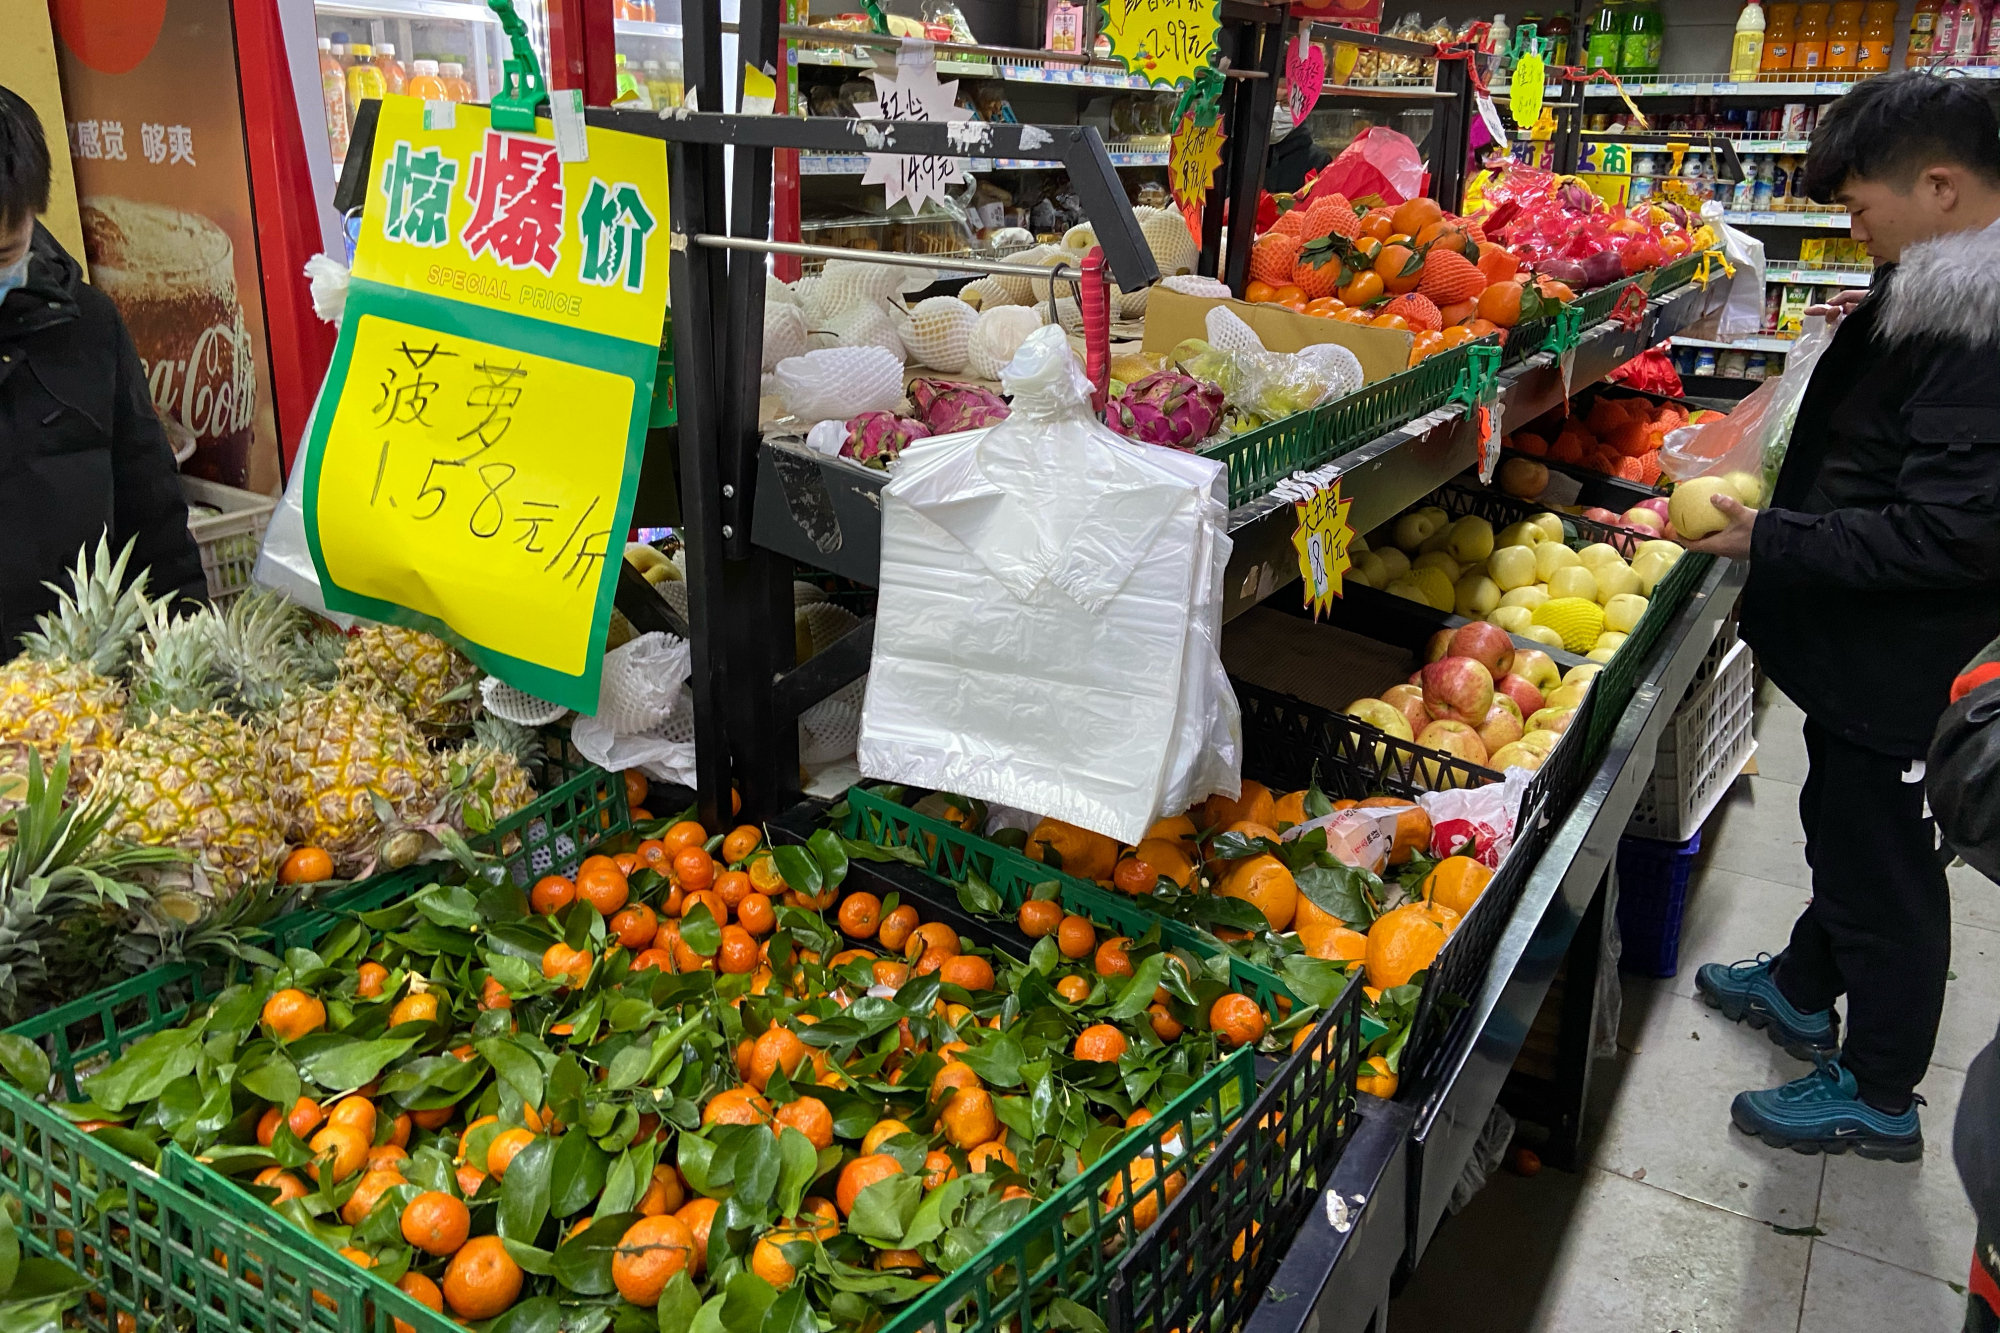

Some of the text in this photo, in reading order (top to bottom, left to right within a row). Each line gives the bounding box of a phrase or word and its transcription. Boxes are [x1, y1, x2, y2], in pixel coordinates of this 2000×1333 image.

[1146, 19, 1213, 65] 2.99元
[880, 88, 922, 121] 红心
[140, 122, 196, 167] 够爽
[901, 153, 955, 192] 14.9元
[382, 130, 656, 293] 惊爆价
[427, 264, 583, 317] SPECIAL PRICE
[371, 341, 528, 463] 菠萝
[370, 440, 614, 592] 1.58元/斤
